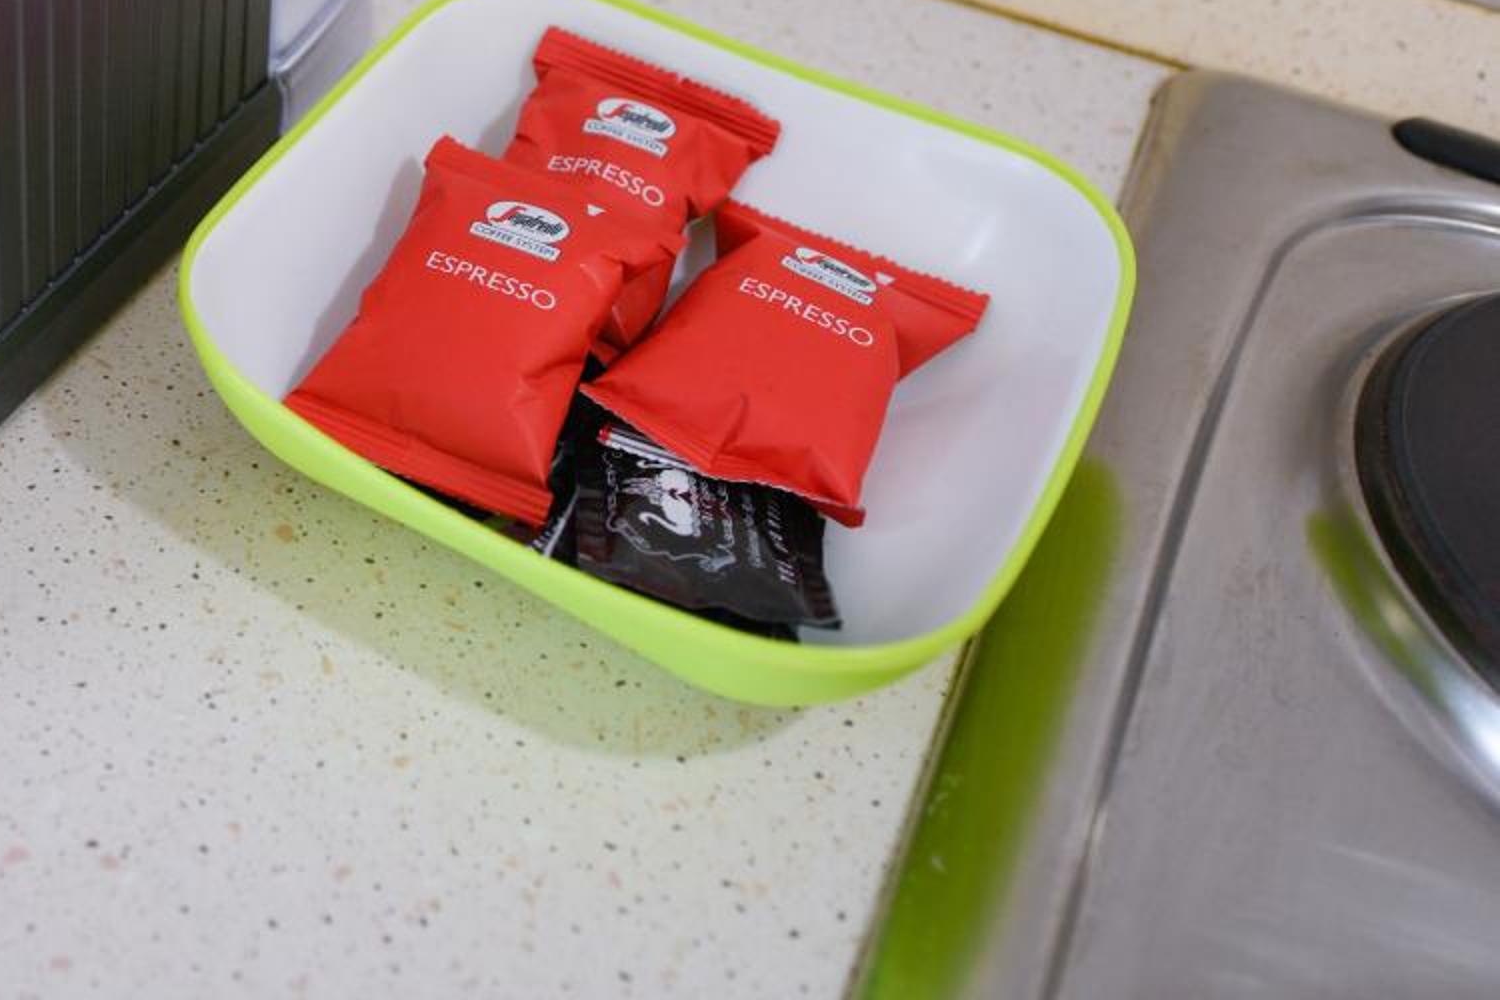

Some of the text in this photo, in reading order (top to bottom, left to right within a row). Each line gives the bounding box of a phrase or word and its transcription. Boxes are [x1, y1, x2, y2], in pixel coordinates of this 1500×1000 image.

[547, 155, 665, 207] ESPRESSO
[425, 250, 557, 310] ESPRESSO
[738, 277, 874, 346] ESPRESSO
